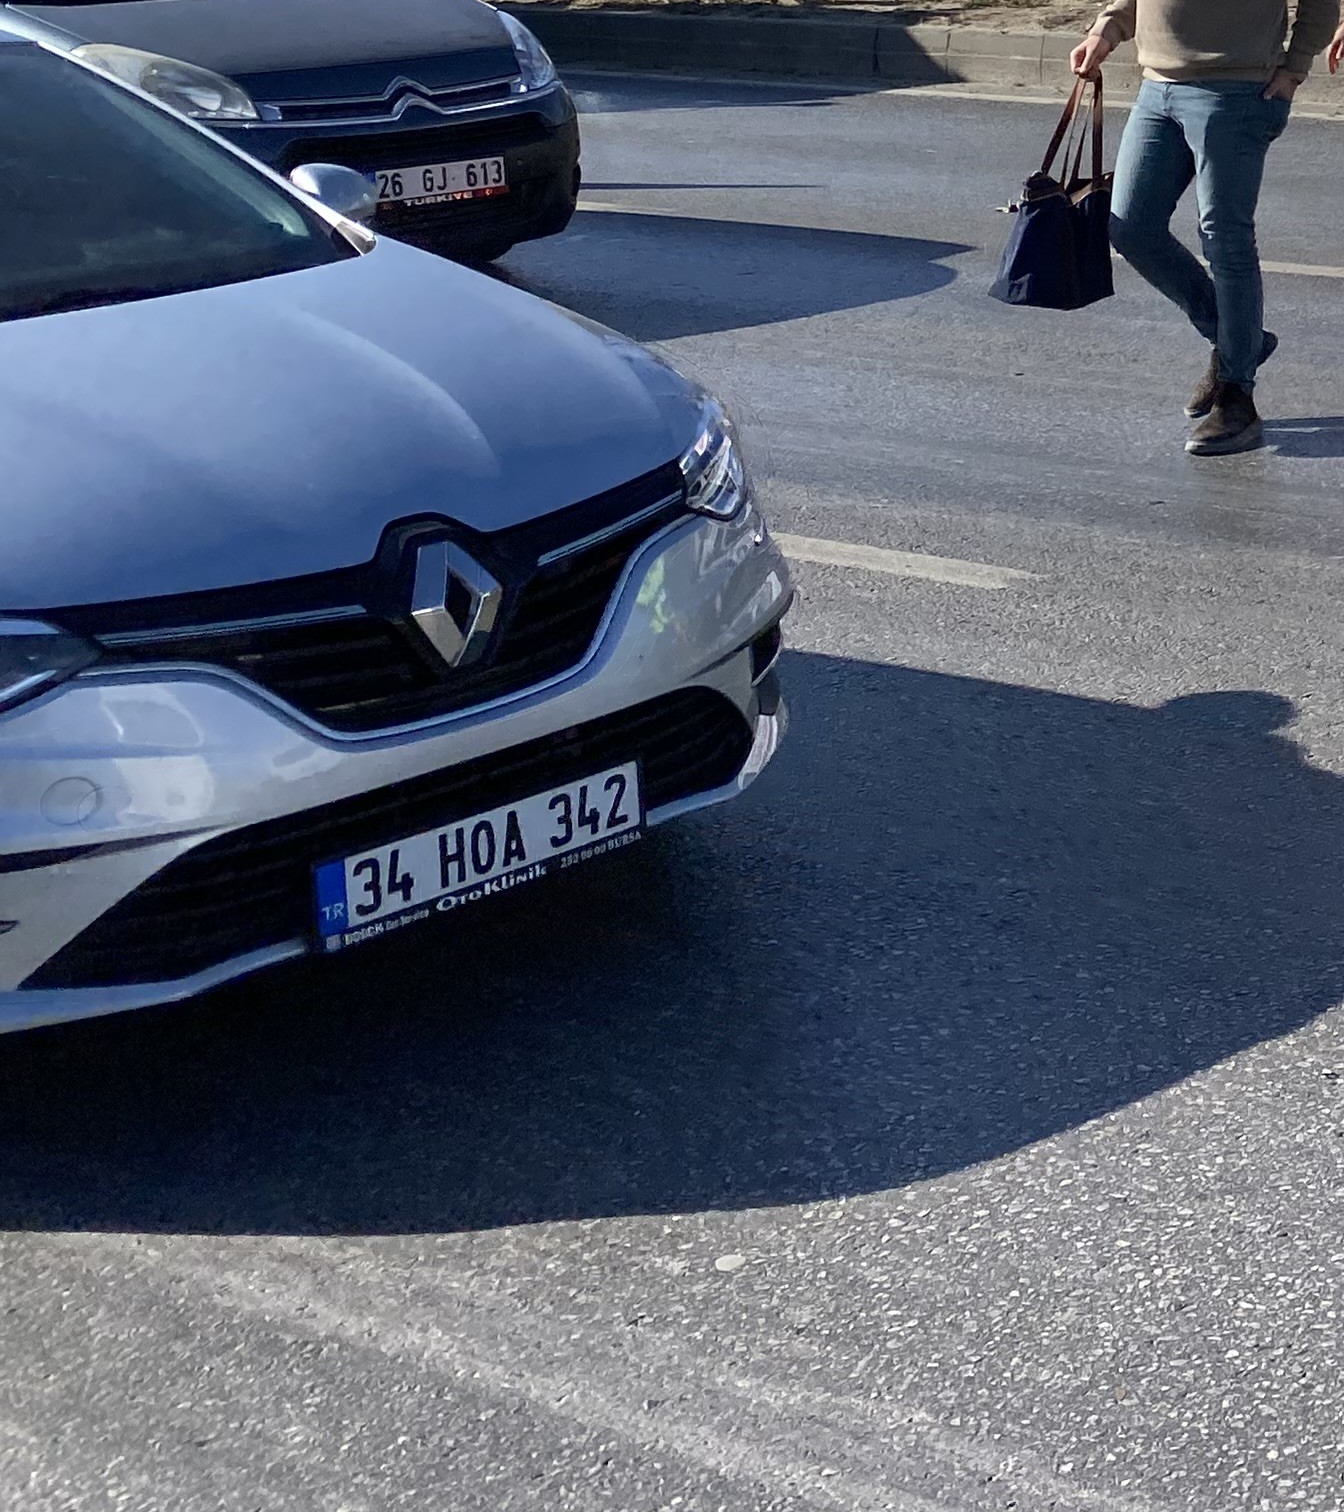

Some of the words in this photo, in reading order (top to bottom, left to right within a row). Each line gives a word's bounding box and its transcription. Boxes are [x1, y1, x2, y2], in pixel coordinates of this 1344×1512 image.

[378, 172, 404, 199] 26
[422, 166, 448, 193] GJ
[465, 160, 502, 187] 613
[352, 849, 414, 918] 34
[438, 809, 527, 889] HOA
[547, 773, 630, 849] 342
[321, 902, 346, 921] TR
